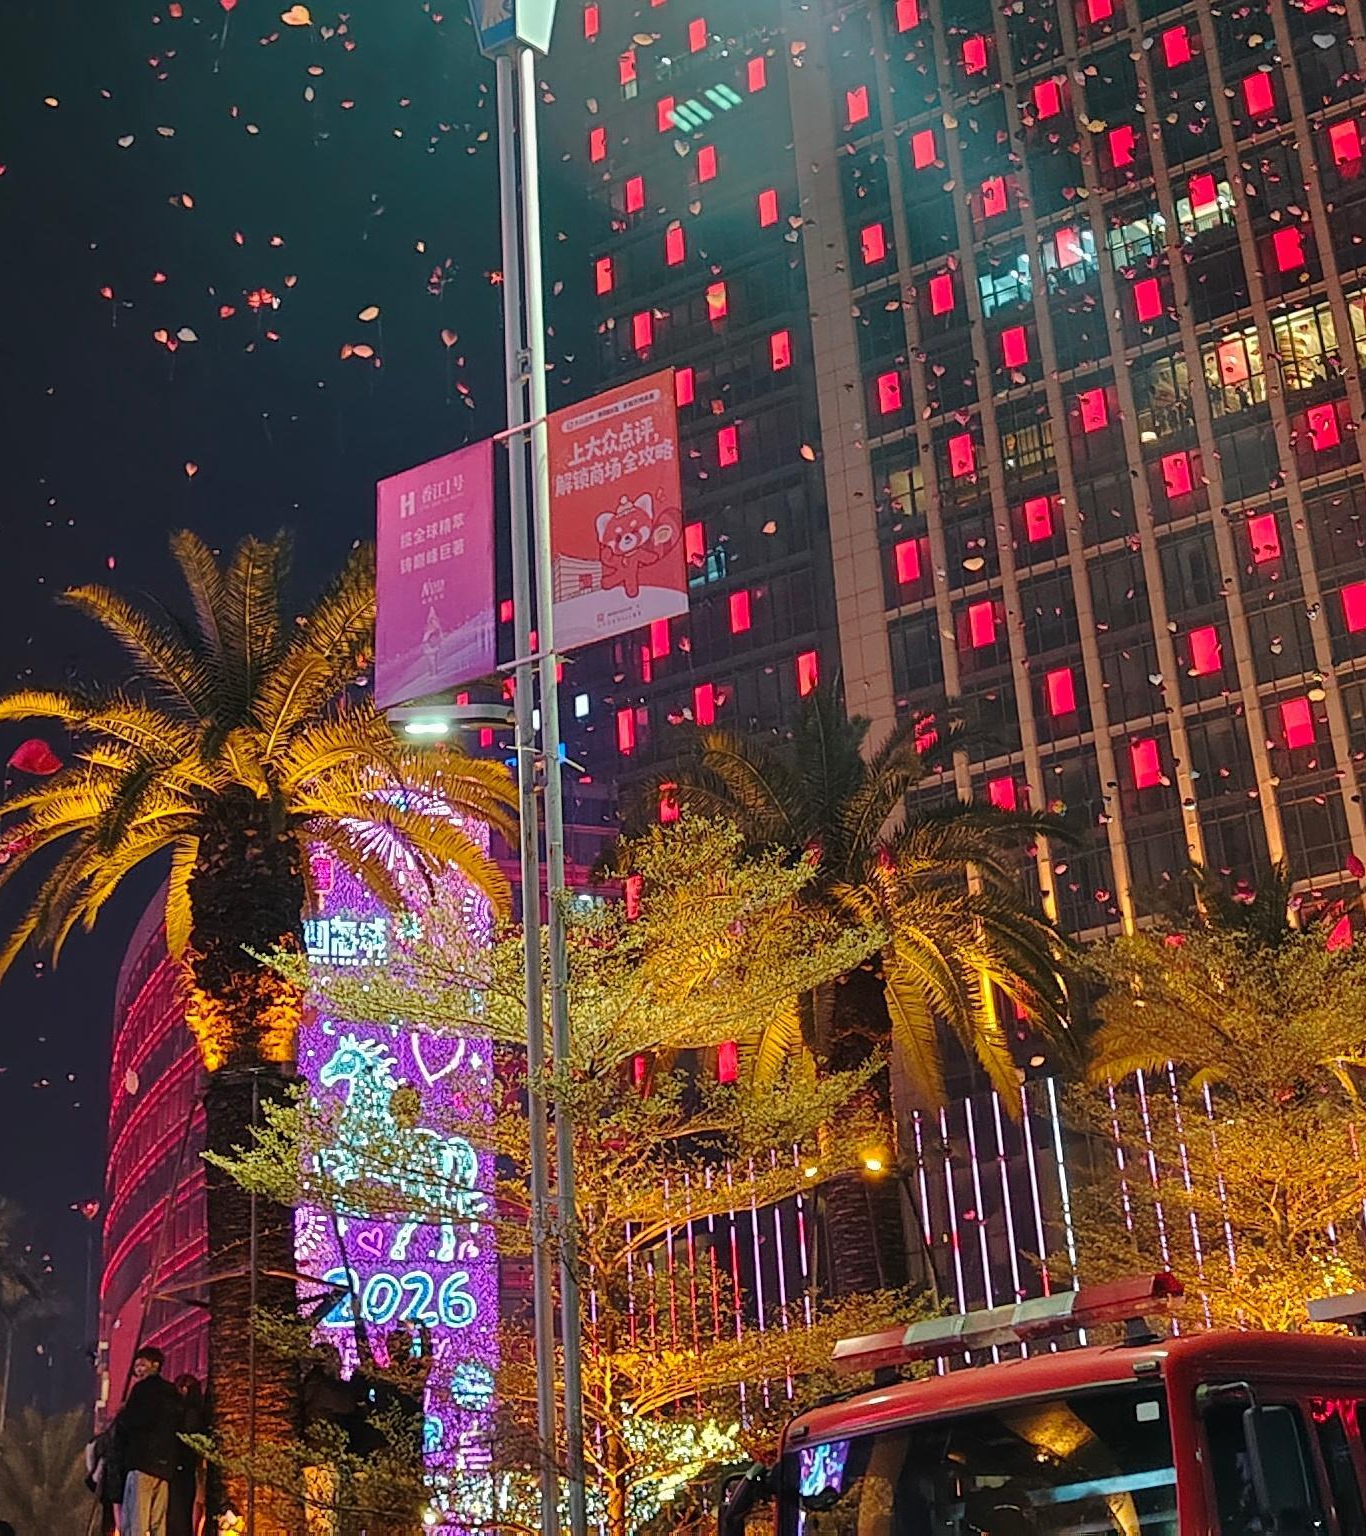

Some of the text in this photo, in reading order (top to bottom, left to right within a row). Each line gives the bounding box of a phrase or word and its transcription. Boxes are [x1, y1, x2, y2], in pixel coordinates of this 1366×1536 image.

[555, 437, 675, 497] 解锁商场全攻略
[399, 491, 416, 520] H
[321, 1266, 478, 1329] 2026
